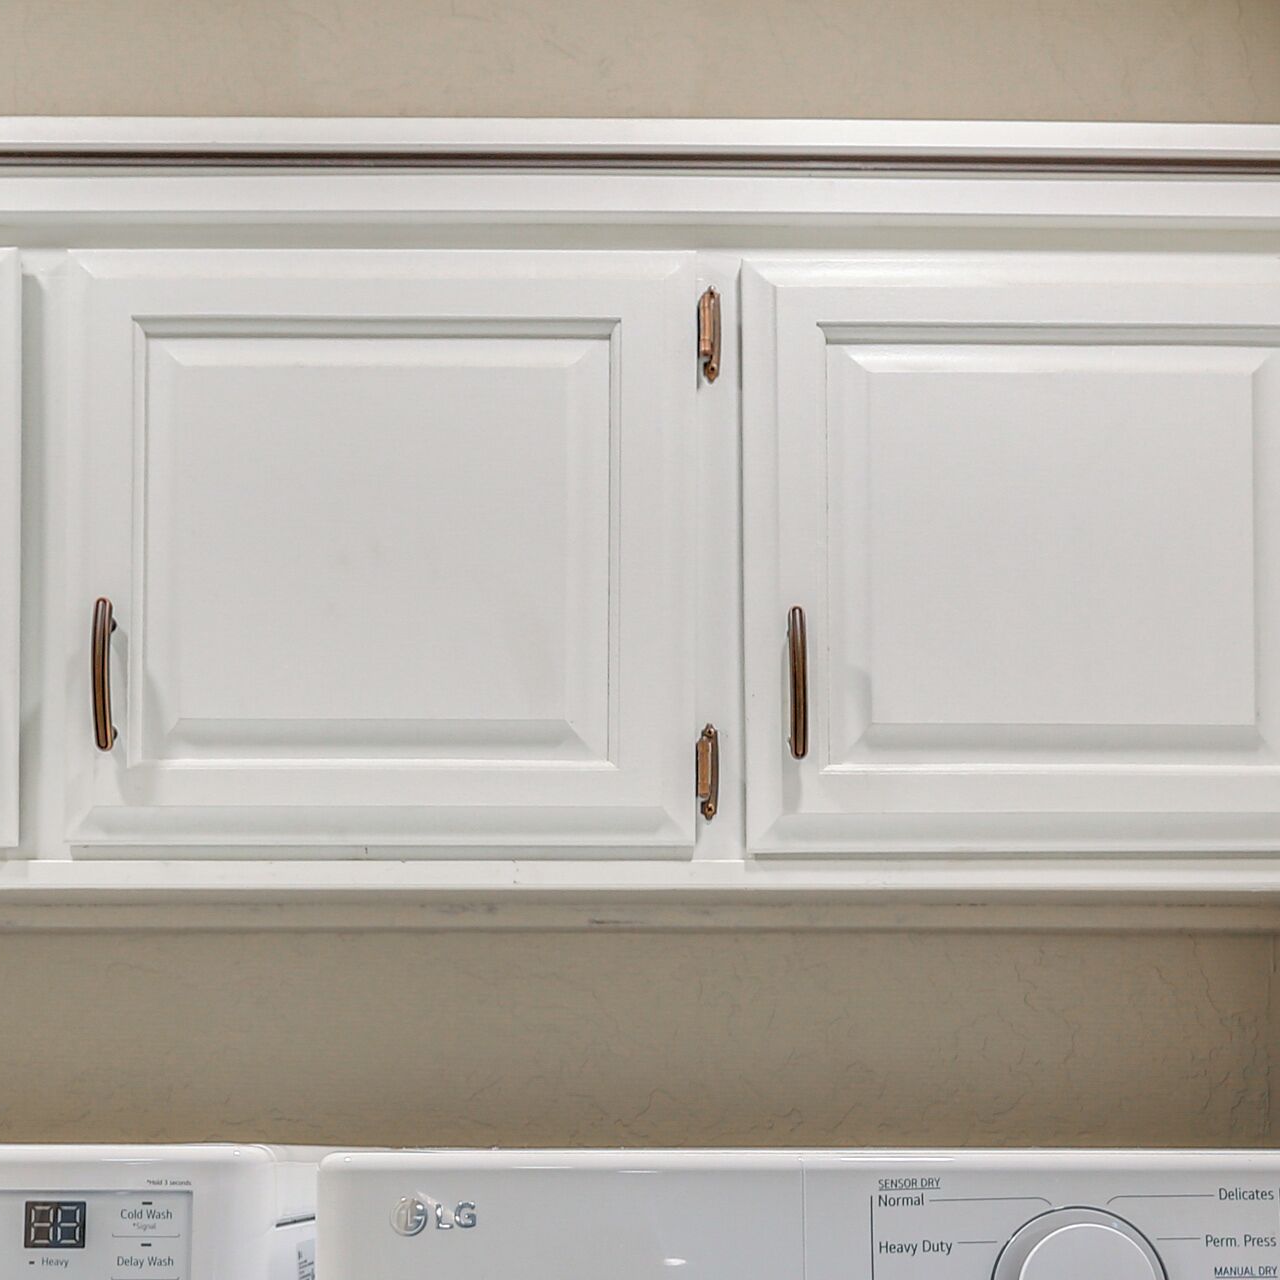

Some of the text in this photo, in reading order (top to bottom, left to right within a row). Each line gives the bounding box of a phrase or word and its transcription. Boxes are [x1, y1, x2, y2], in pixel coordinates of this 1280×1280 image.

[878, 1178, 941, 1189] SENSOR DRY
[1218, 1187, 1275, 1201] Delicates
[878, 1194, 925, 1208] Normal
[120, 1209, 172, 1219] Cold Wash
[435, 1200, 477, 1229] LG
[879, 1240, 953, 1255] Heavy Duty
[1205, 1234, 1277, 1248] Perm. Press
[42, 1257, 69, 1268] Heavy
[117, 1256, 174, 1268] Delay Wash
[1214, 1265, 1277, 1276] MANUAL DRY
